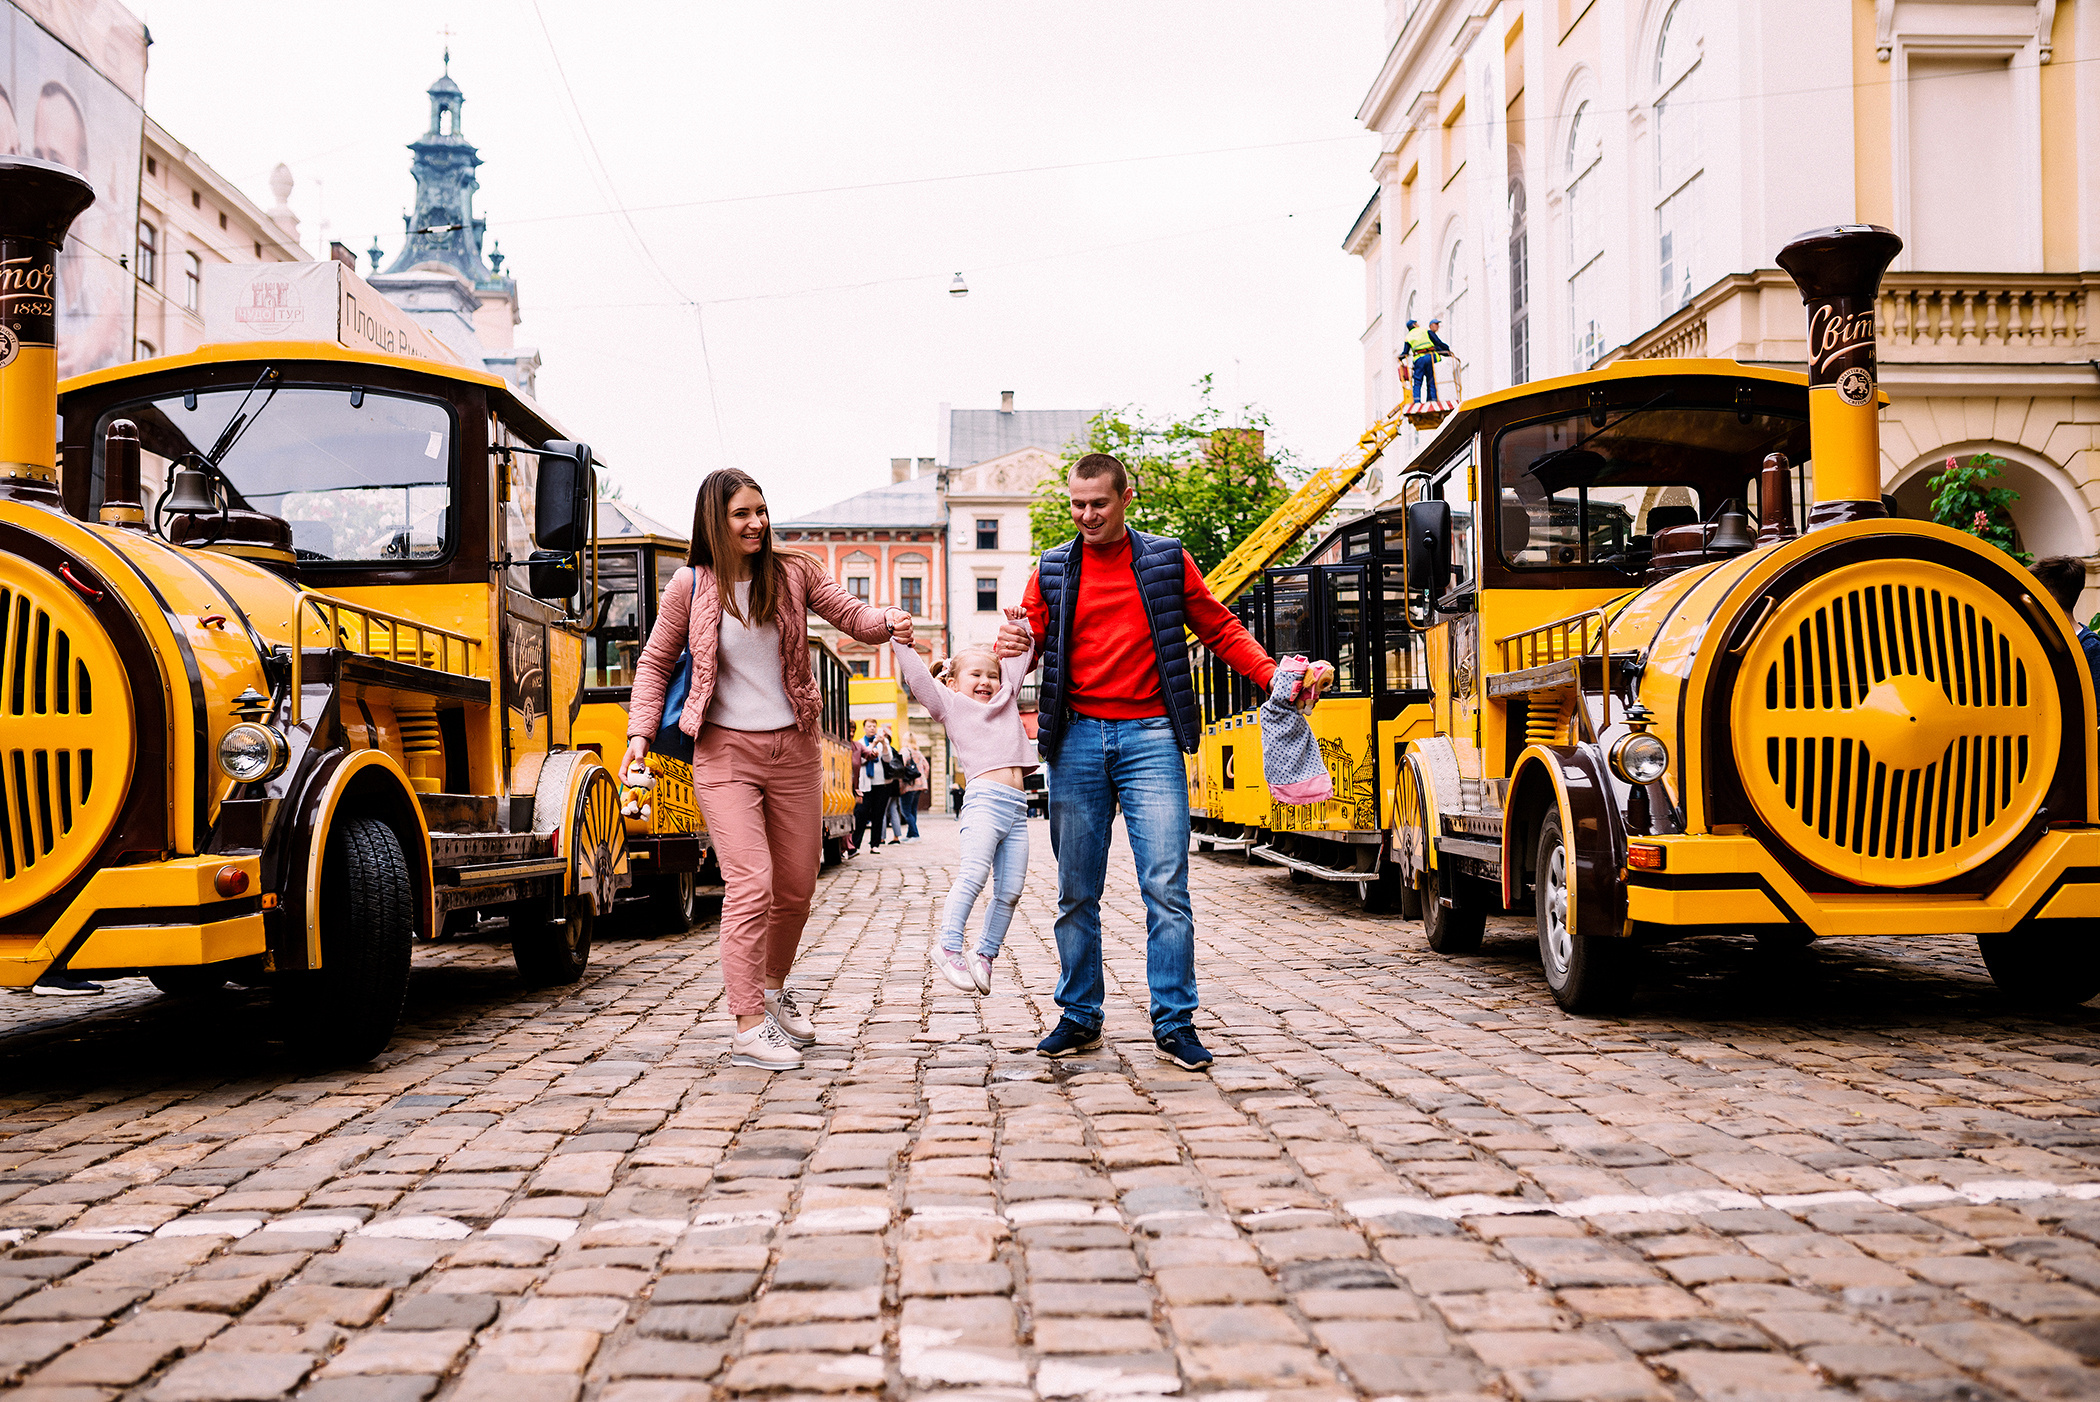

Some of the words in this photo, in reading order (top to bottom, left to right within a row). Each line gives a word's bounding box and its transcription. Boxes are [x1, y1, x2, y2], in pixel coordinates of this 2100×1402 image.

[13, 302, 53, 317] 1882
[278, 309, 301, 320] ТУР
[346, 291, 395, 353] Площа
[1809, 304, 1876, 366] Світ
